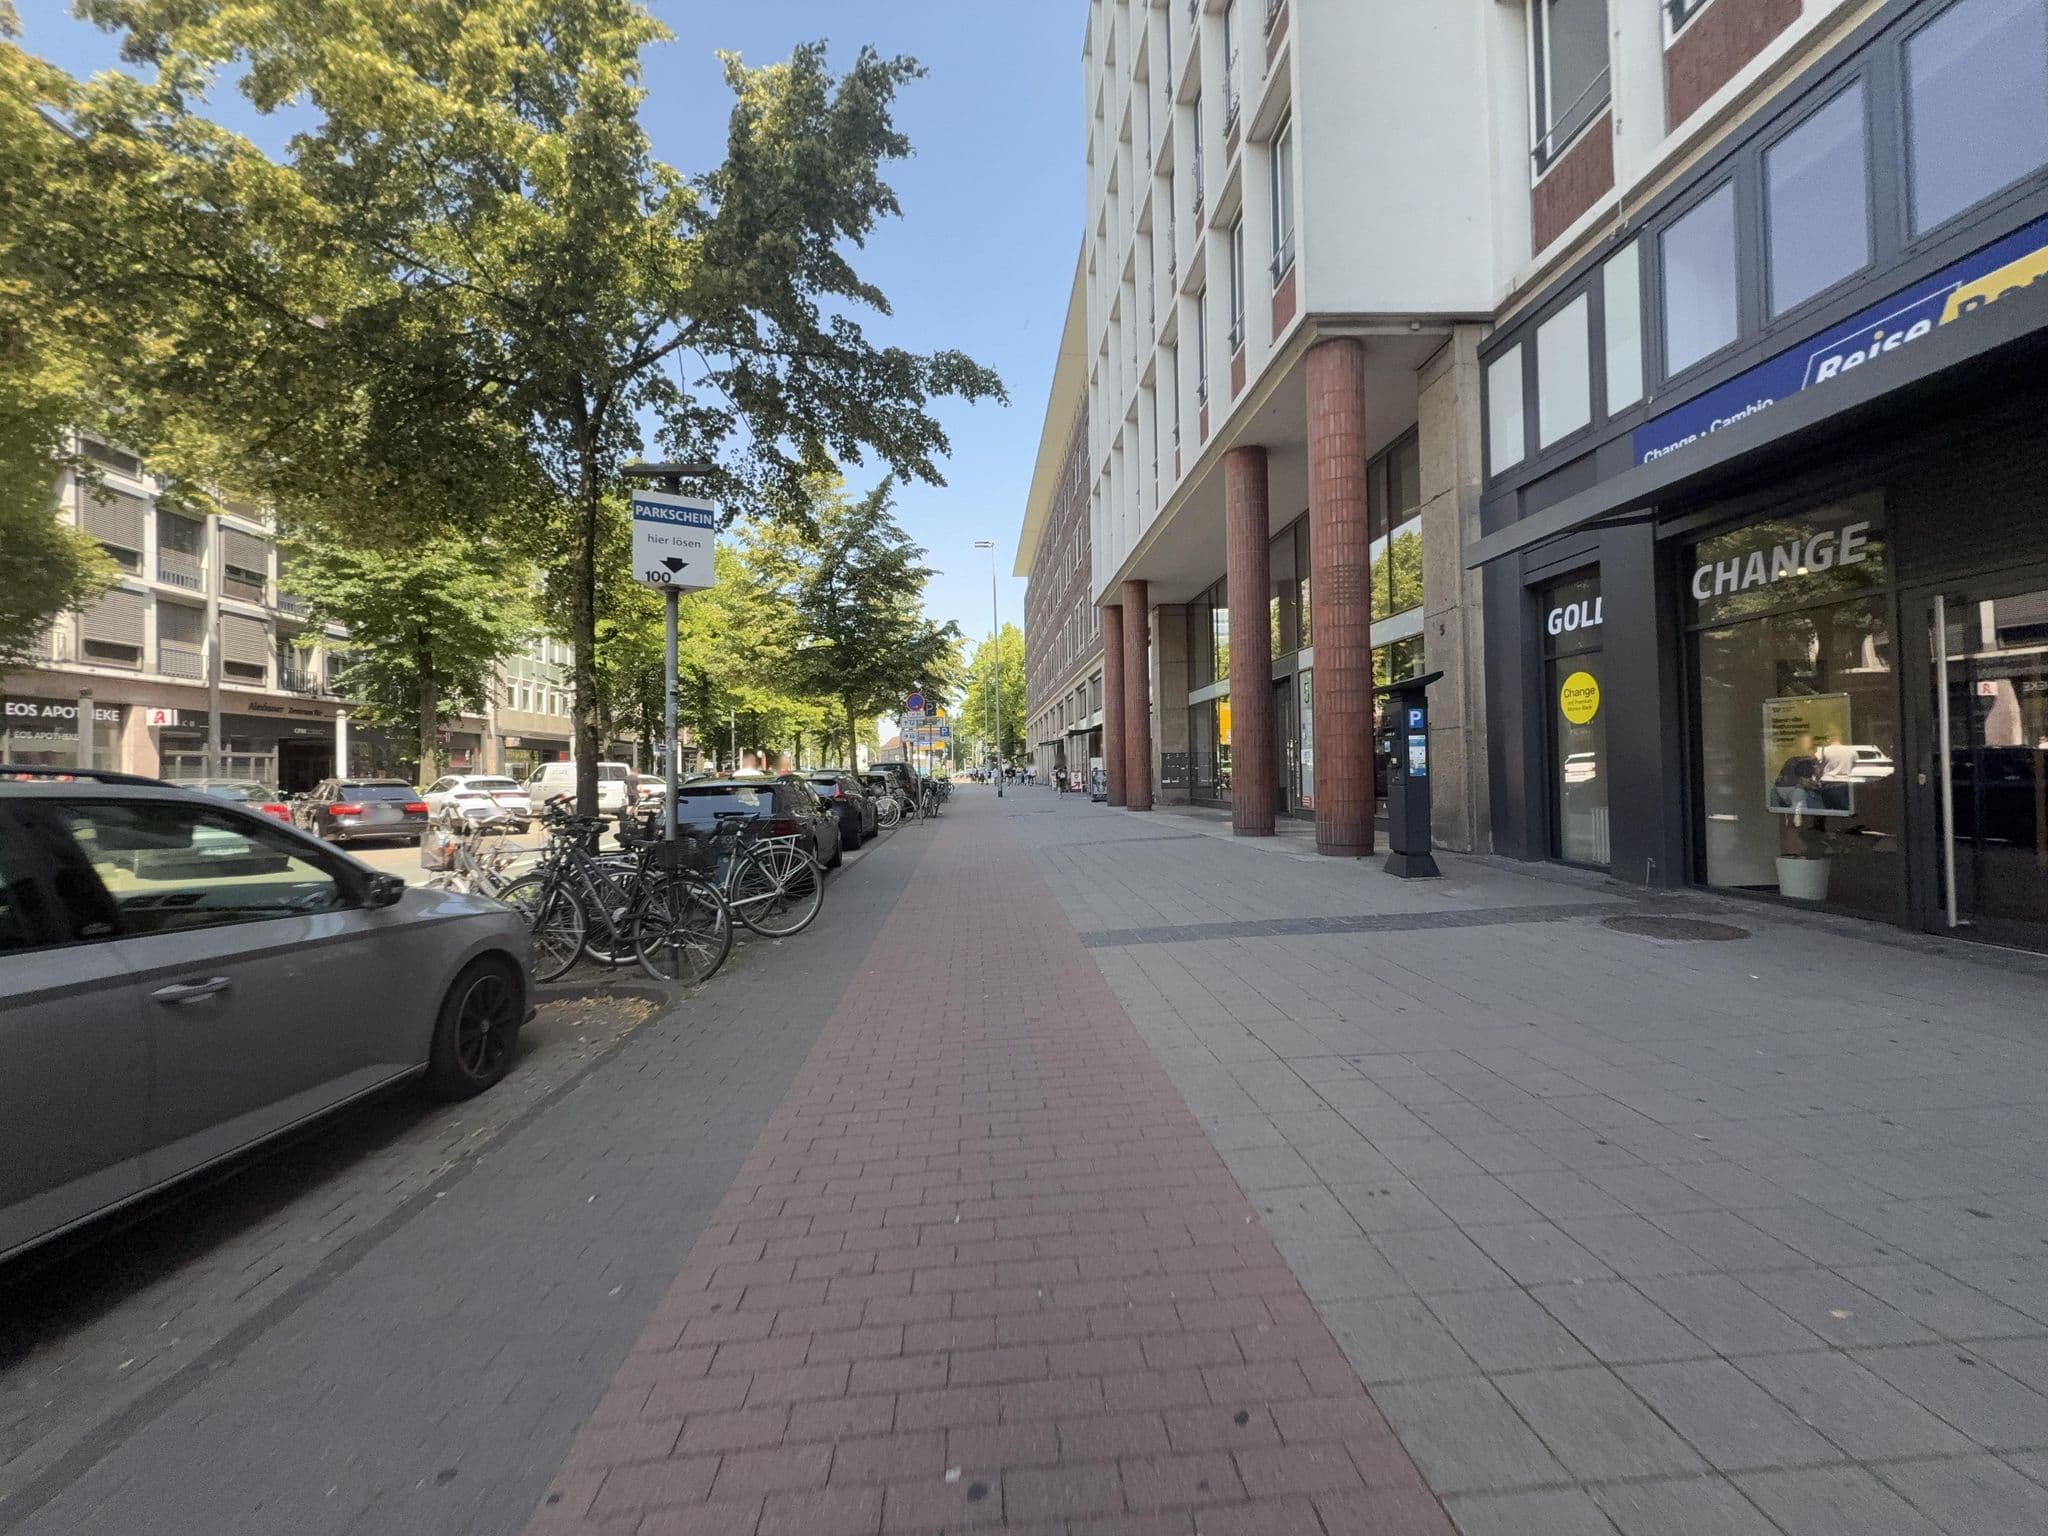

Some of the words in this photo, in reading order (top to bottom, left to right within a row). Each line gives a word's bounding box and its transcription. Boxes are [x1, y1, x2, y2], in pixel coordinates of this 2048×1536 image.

[635, 504, 712, 526] PARKSCHEIN
[647, 533, 669, 545] hier
[672, 536, 702, 549] lösen
[1692, 520, 1871, 600] CHANGE
[645, 570, 672, 583] 100
[1563, 687, 1596, 699] Change
[5, 702, 38, 717] EOS
[41, 705, 121, 722] APOEKE
[1410, 710, 1422, 726] P
